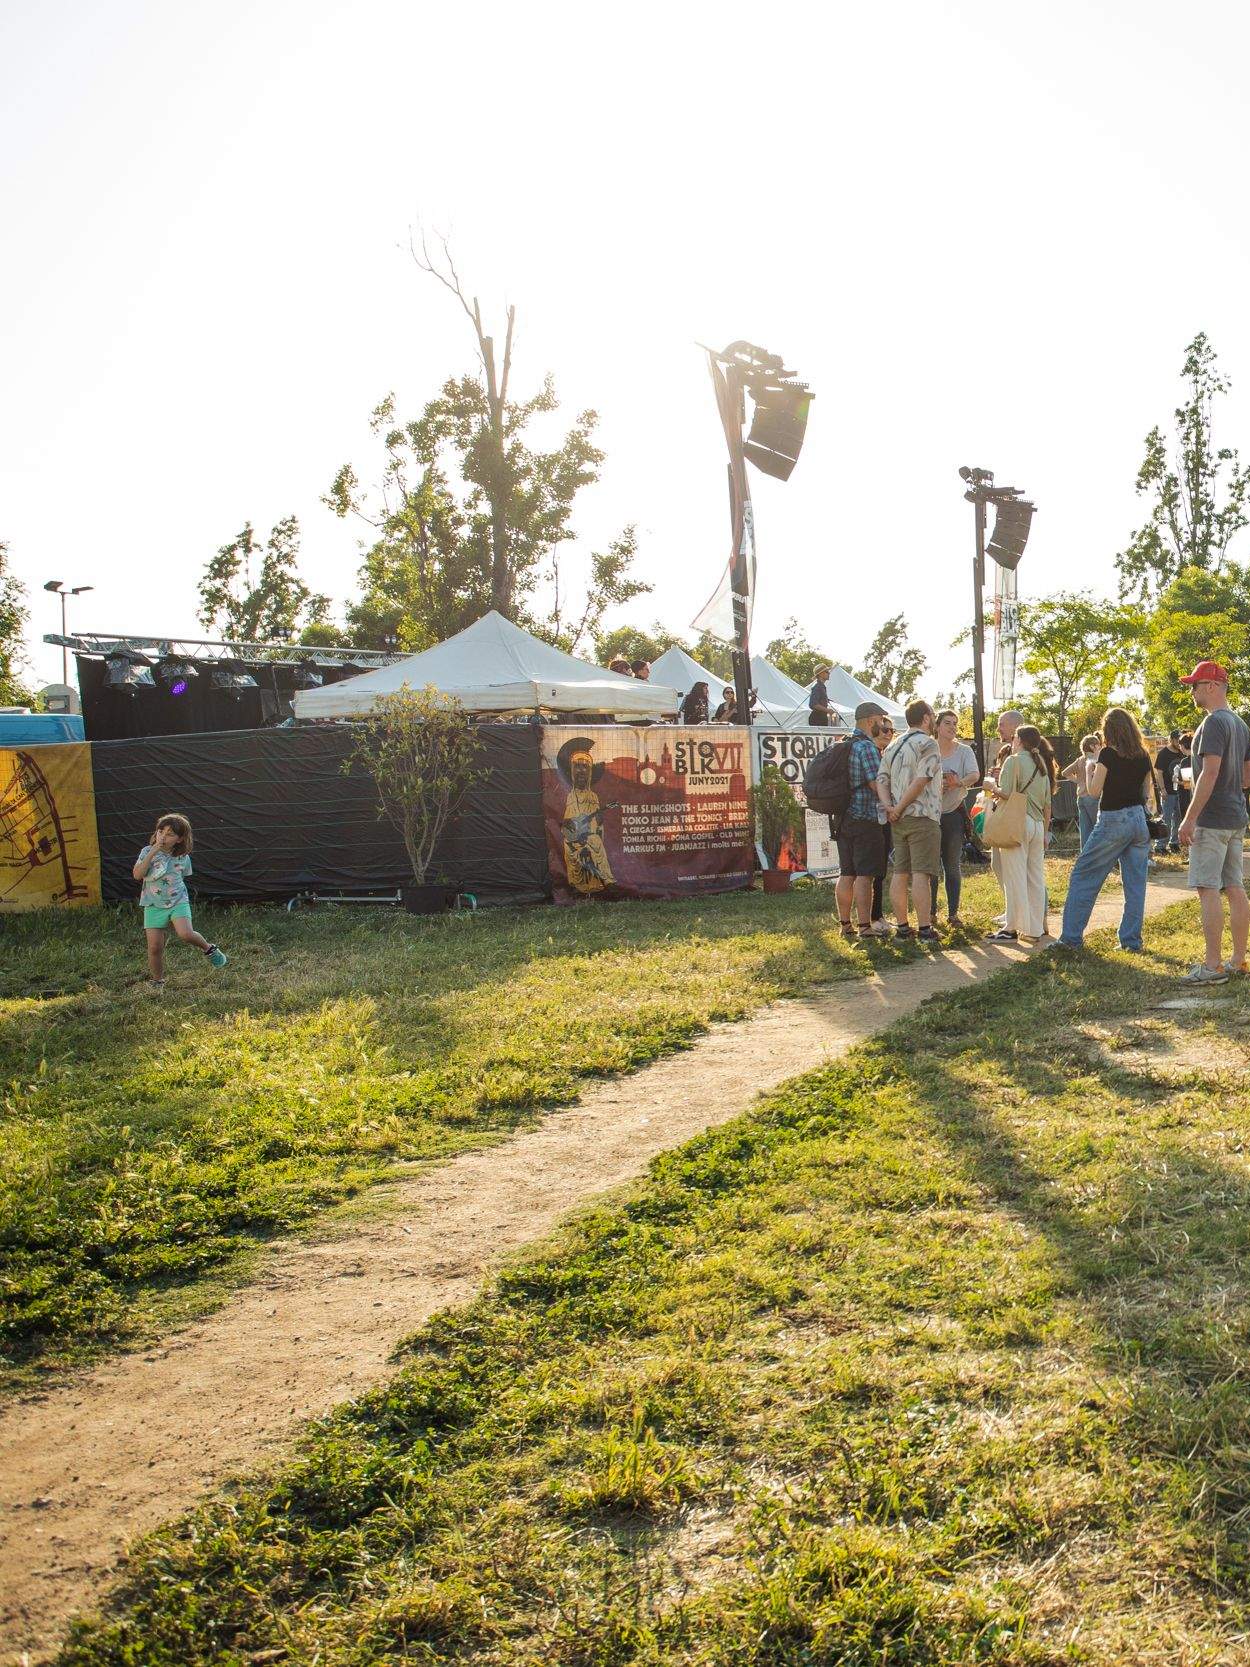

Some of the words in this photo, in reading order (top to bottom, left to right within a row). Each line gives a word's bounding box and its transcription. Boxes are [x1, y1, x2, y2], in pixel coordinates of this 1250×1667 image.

[621, 804, 638, 814] THE
[640, 803, 691, 814] SLINGSHOTS
[621, 816, 649, 825] KOKO
[651, 815, 670, 825] JEAN
[672, 815, 679, 823] &
[681, 814, 696, 823] THE
[697, 813, 722, 822] TONICS
[629, 826, 654, 834] CIEGAS
[657, 825, 693, 833] ESMERALDA
[622, 835, 645, 843] TONIA
[691, 833, 715, 841] GOSPEL
[623, 844, 654, 853] MARKUS
[656, 844, 666, 852] FM
[671, 842, 706, 851] JUANJAZZ
